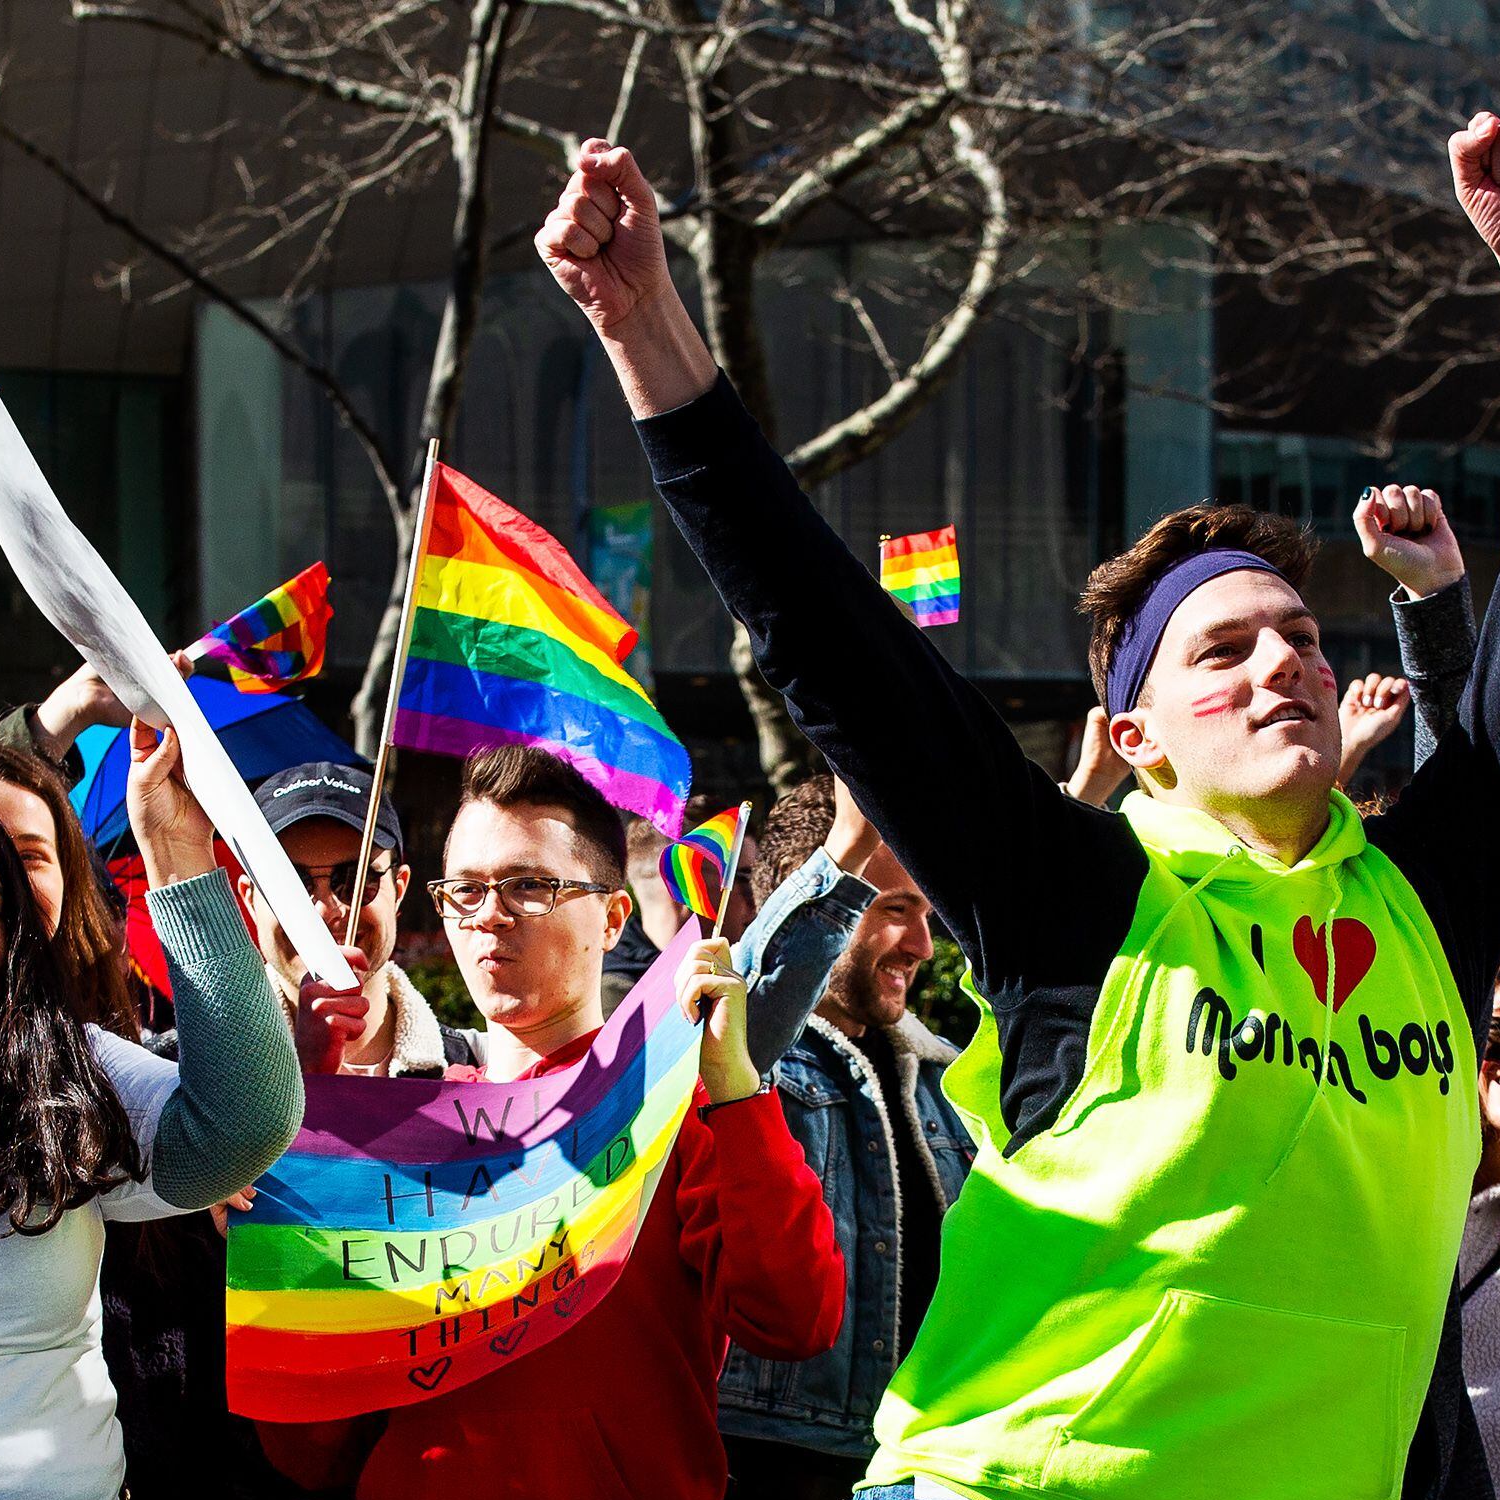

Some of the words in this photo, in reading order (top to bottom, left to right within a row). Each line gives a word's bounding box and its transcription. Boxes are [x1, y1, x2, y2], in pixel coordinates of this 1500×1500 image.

[272, 777, 323, 798] Outdoor
[322, 775, 362, 795] Voices
[341, 1136, 631, 1283] ENDURED
[398, 1239, 596, 1357] THINGS
[434, 1229, 571, 1315] MANY
